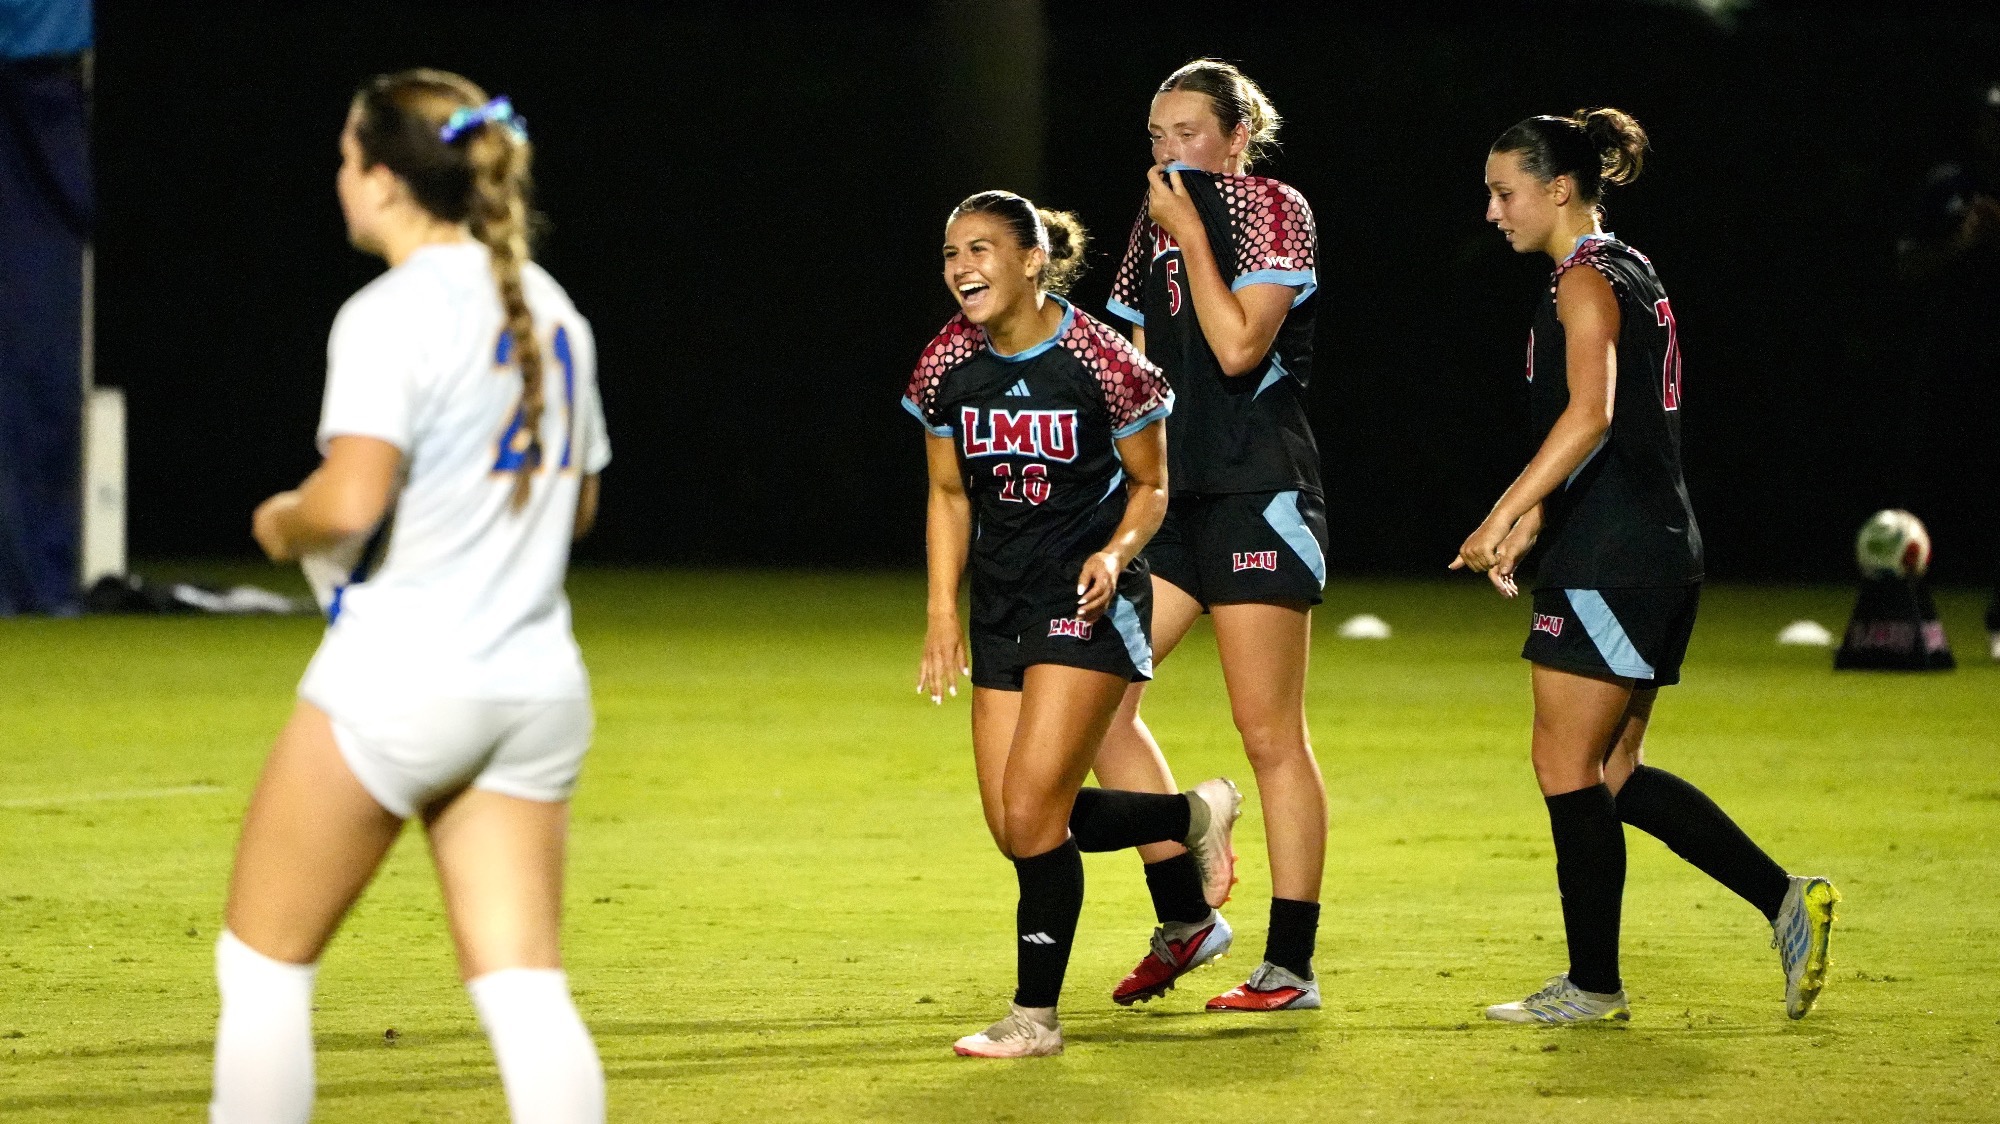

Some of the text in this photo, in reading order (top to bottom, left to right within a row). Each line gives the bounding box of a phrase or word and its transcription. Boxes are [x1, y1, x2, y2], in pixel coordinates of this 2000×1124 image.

[1167, 258, 1182, 317] 5
[1654, 297, 1682, 411] 2
[961, 406, 1079, 463] LMU
[993, 463, 1051, 505] 16
[1233, 550, 1277, 572] LMU
[1047, 618, 1093, 641] LMU
